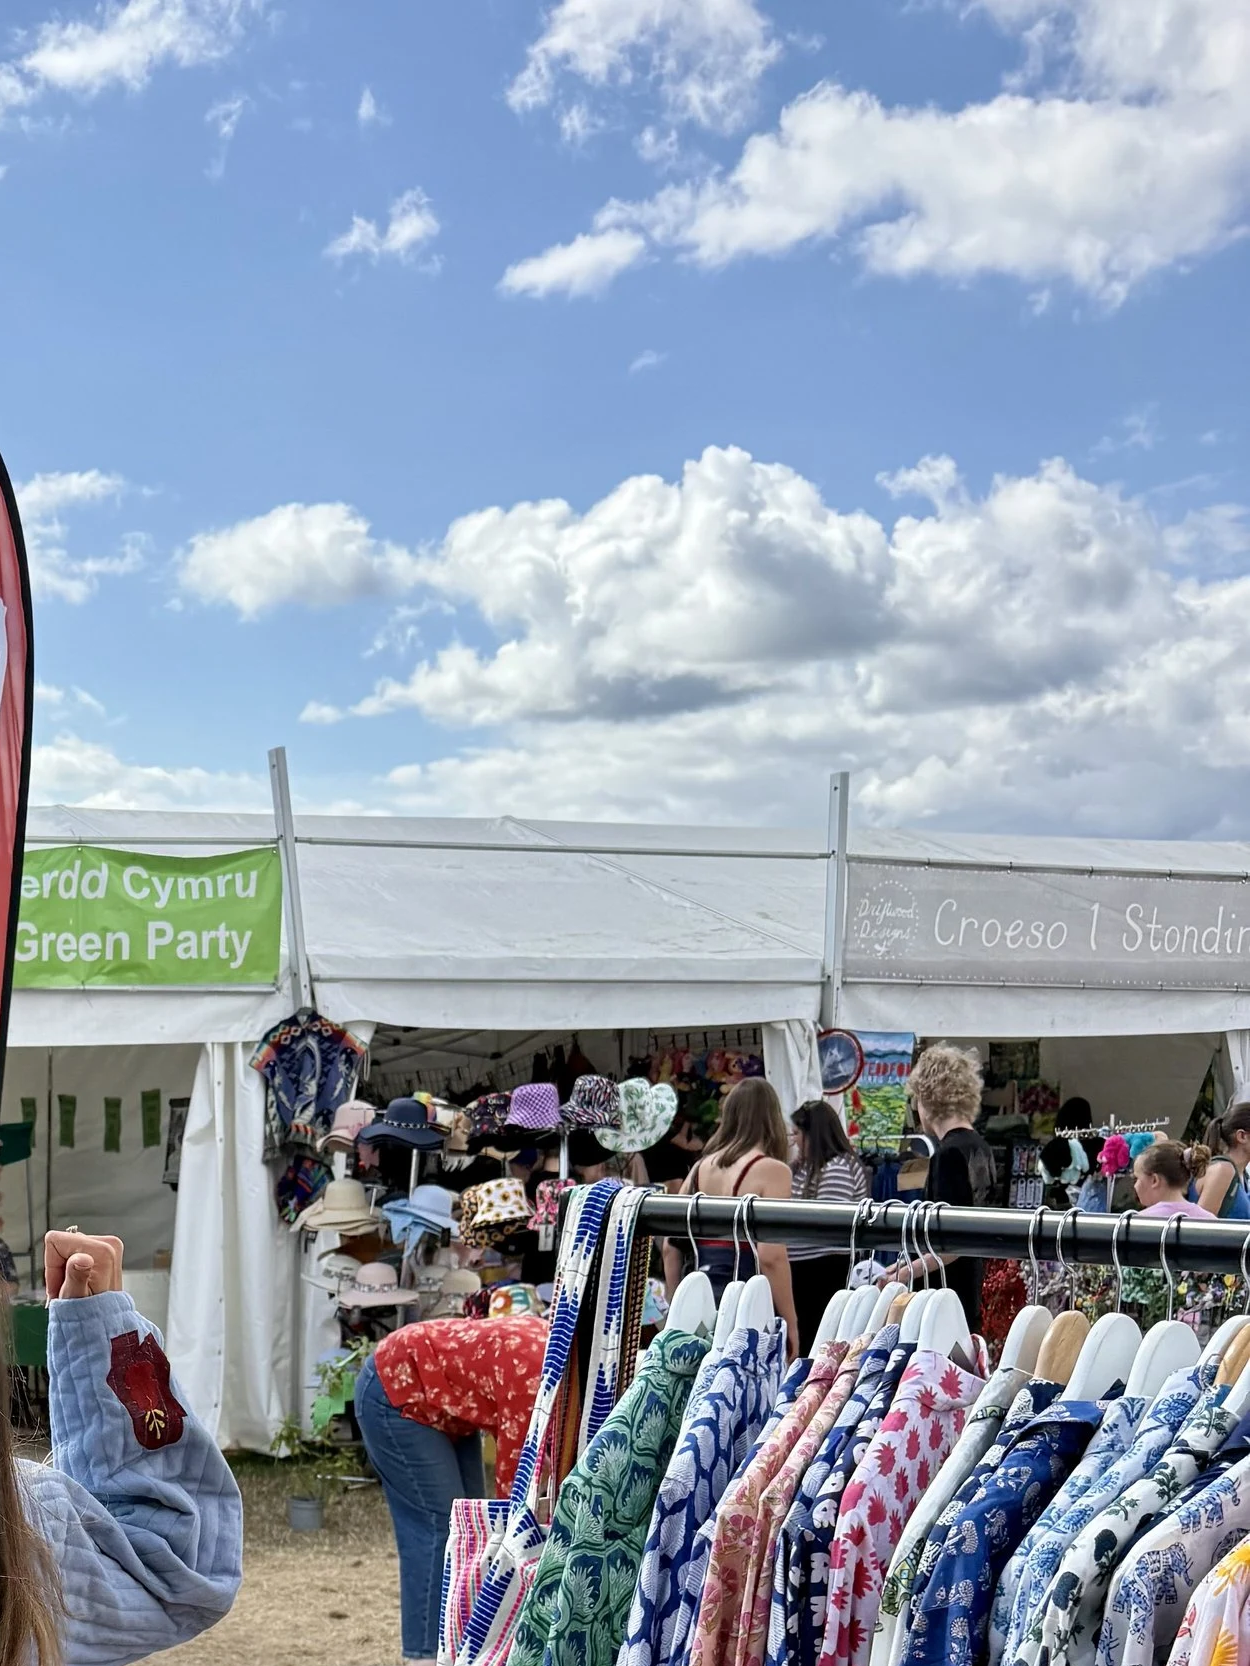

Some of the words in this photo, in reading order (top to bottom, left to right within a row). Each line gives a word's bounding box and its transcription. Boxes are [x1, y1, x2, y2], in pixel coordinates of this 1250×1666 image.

[122, 865, 258, 909] Cymru
[14, 921, 131, 962] Green
[147, 920, 253, 969] Party
[934, 899, 1068, 949] Croeso
